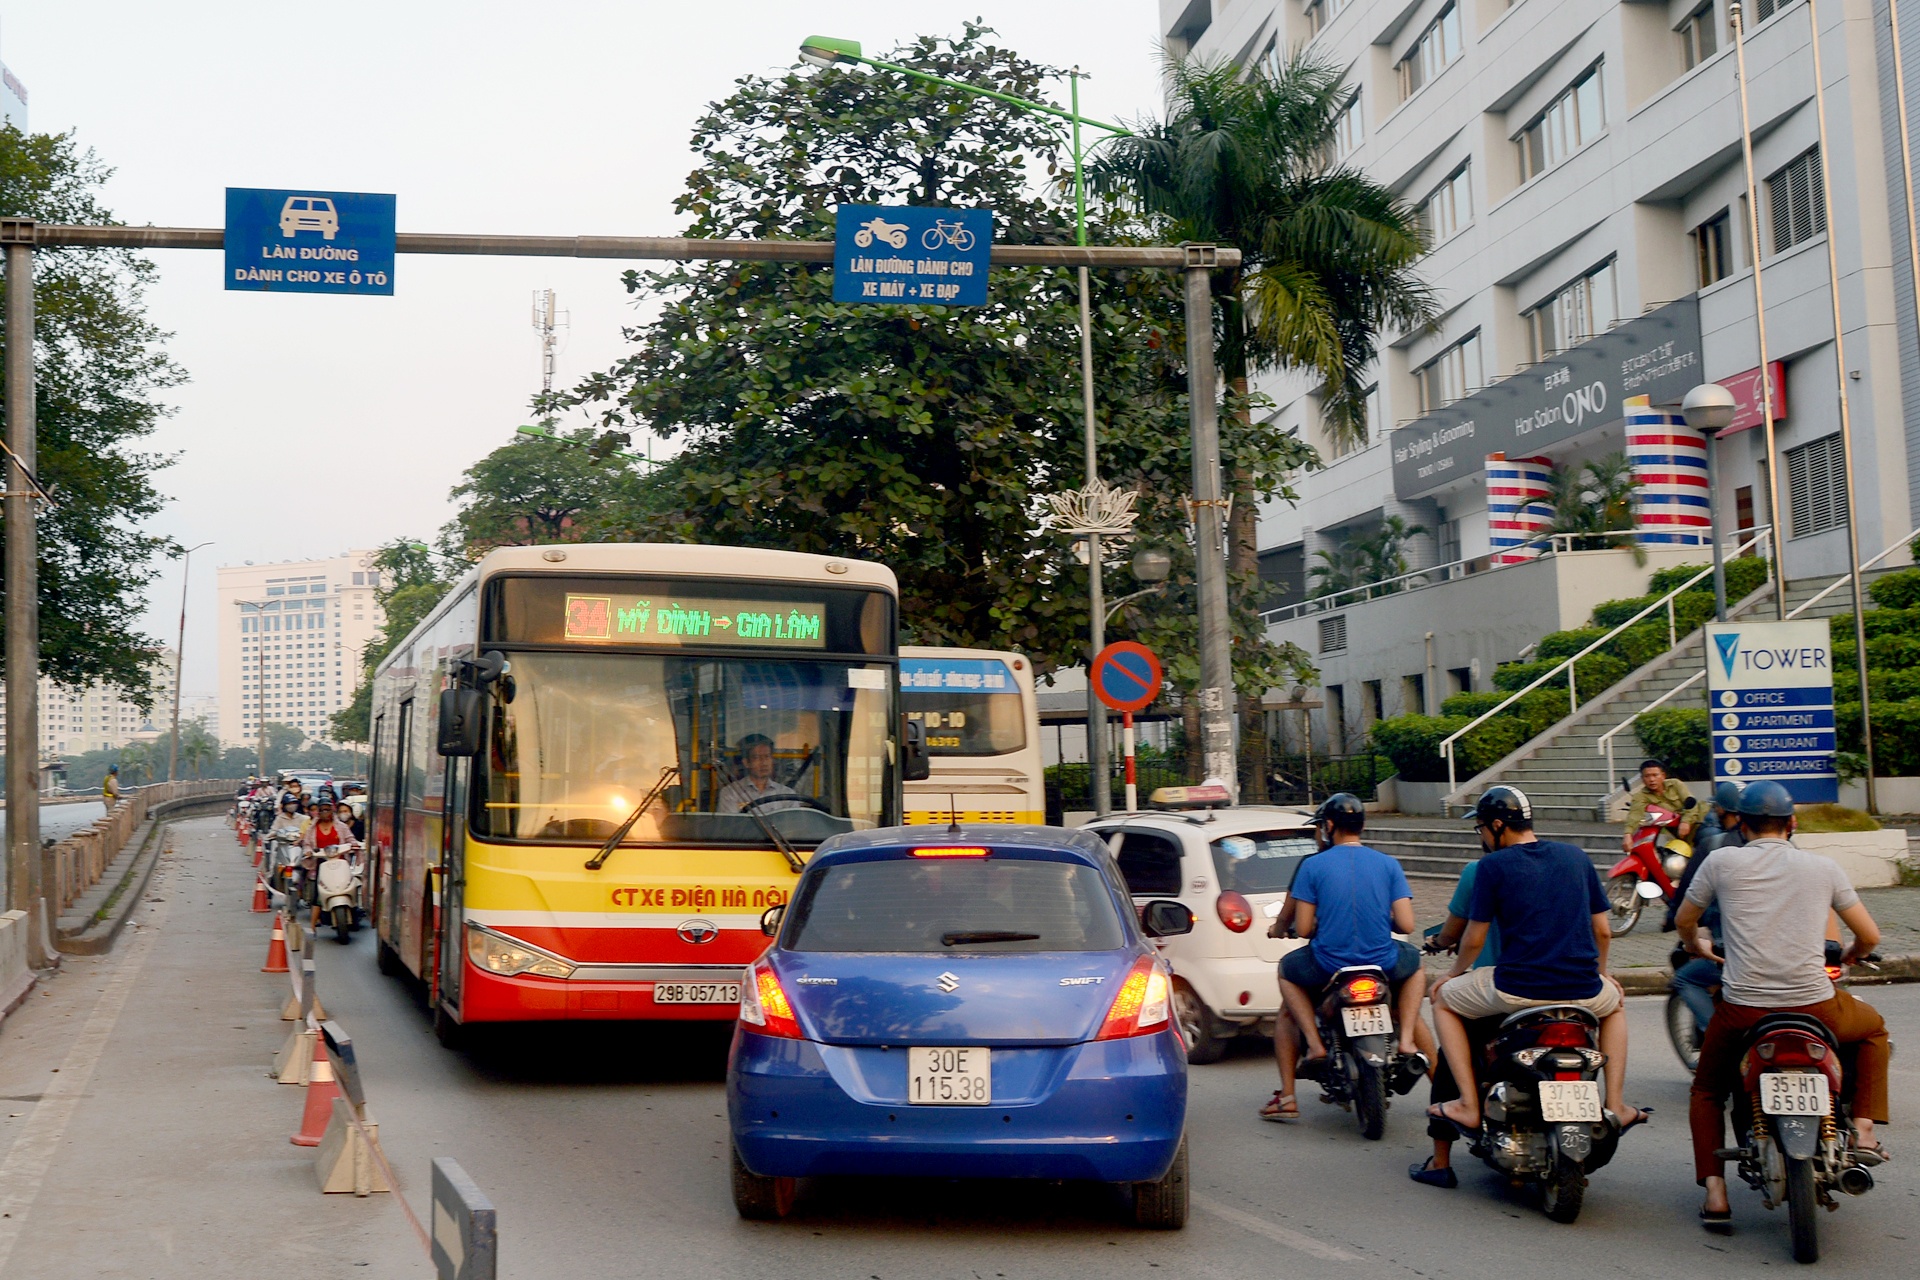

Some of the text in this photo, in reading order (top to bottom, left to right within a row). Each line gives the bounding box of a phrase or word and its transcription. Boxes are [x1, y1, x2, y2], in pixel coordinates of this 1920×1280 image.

[263, 244, 358, 261] LÀN ĐƯỜNG
[235, 266, 387, 286] DÀNH CHO XE Ô TÔ
[850, 255, 873, 274] LÀN
[917, 257, 948, 276] DÀNH
[950, 261, 973, 277] CHO
[862, 281, 878, 297] XE
[880, 280, 906, 298] MÁY
[919, 283, 935, 298] XE
[937, 284, 960, 301] ĐẠP
[1544, 366, 1570, 392] 日本橋
[1514, 381, 1607, 437] Hair Salon ONO
[1394, 447, 1409, 464] Hair
[1408, 438, 1433, 459] Styling
[1439, 421, 1475, 445] Grooming
[568, 600, 820, 640] 34 MỸ ĐÌNH GIA LÂM
[1740, 648, 1827, 671] TOWER
[1744, 692, 1785, 705] OFFICE
[1745, 714, 1814, 727] APARTMENT
[1747, 737, 1818, 749] RESTAURANT
[1748, 759, 1828, 773] SUPERMARKET
[671, 884, 715, 913] ĐIỆN
[722, 885, 746, 907] HÀ
[1059, 976, 1105, 986] SWIFT
[1353, 1020, 1385, 1034] 4478
[928, 1049, 969, 1073] 30E
[915, 1076, 985, 1100] 115.38
[1771, 1077, 1816, 1093] 35-H1
[1546, 1102, 1597, 1118] 554.59
[1773, 1095, 1818, 1111] 6580
